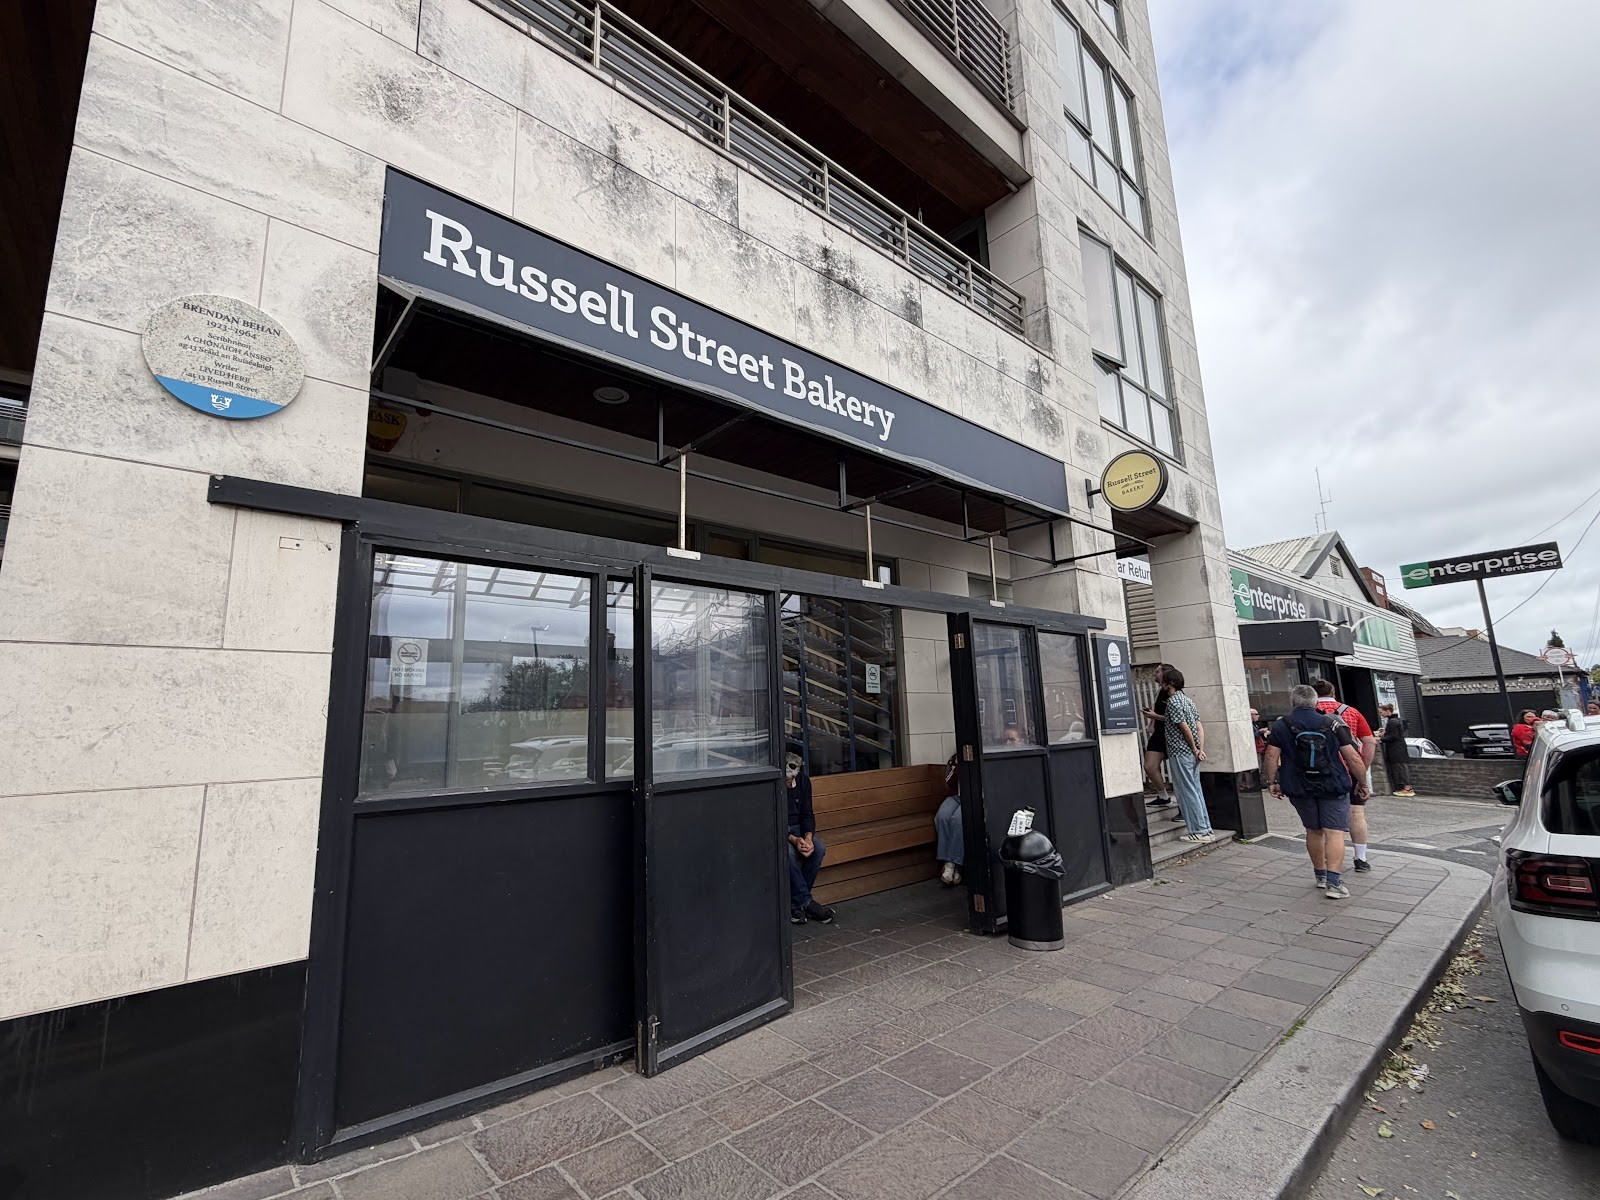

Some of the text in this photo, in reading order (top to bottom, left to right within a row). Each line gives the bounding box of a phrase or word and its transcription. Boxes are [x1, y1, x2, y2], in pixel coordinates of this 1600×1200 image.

[183, 302, 281, 337] BRENDAN BEHAN
[423, 209, 895, 441] Russell Street Bakery
[200, 365, 251, 384] LIVED HERE
[214, 360, 240, 373] Writer
[207, 375, 234, 388] Russell
[236, 382, 259, 394] Street
[1106, 467, 1157, 488] Russell Street
[1121, 484, 1145, 495] BAKERY
[1117, 561, 1150, 580] ar Retur
[1403, 549, 1559, 581] enterprise
[1500, 559, 1560, 574] rent-a-car
[1235, 583, 1307, 620] enterprise
